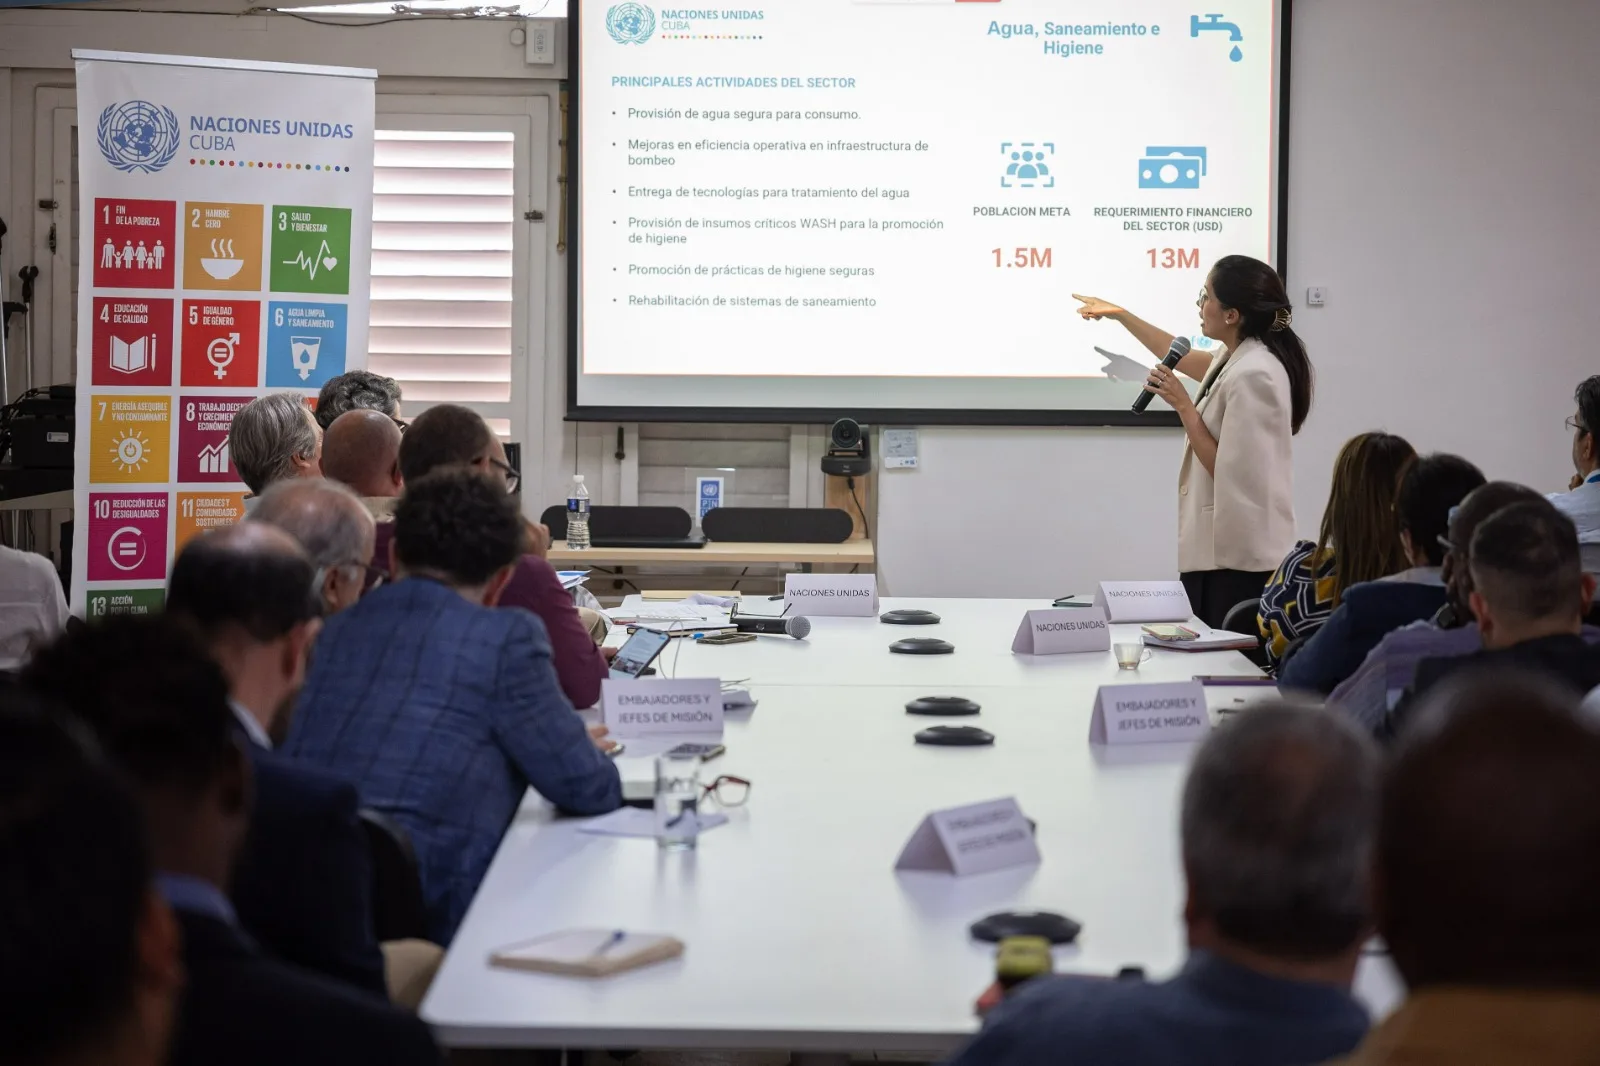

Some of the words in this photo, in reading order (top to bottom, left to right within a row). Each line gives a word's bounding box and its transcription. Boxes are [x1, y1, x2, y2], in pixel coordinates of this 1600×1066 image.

[662, 10, 718, 19] NACIONES
[722, 10, 764, 20] UNIDAS
[661, 20, 690, 30] CUBA
[987, 21, 1038, 38] Agua,
[1044, 21, 1146, 36] Saneamiento
[1151, 25, 1160, 35] e
[1044, 40, 1103, 58] Higiene
[612, 76, 692, 87] PRINCIPALES
[696, 77, 777, 87] ACTIVIDADES
[781, 77, 804, 88] DEL
[807, 78, 855, 88] SECTOR
[628, 108, 681, 118] Provisión
[685, 108, 699, 118] de
[702, 111, 730, 121] agua
[734, 111, 772, 121] segura
[776, 111, 801, 121] para
[805, 111, 861, 119] consumo.
[189, 116, 281, 135] NACIONES
[285, 121, 354, 139] UNIDAS
[189, 134, 236, 151] CUBA
[628, 139, 674, 152] Mejoras
[678, 142, 691, 150] en
[695, 139, 750, 150] eficiencia
[753, 141, 806, 152] operativa
[827, 140, 911, 151] infraestructura
[915, 140, 928, 151] de
[628, 154, 675, 165] bombeo
[629, 186, 672, 199] Entrega
[676, 186, 689, 197] de
[693, 186, 759, 200] tecnologías
[763, 189, 788, 199] para
[792, 187, 857, 197] tratamiento
[861, 187, 878, 197] del
[882, 190, 909, 200] agua
[103, 205, 109, 225] 1
[116, 205, 126, 214] FIN
[205, 209, 230, 219] HAMBRE
[973, 207, 1036, 216] POBLACION
[1040, 207, 1070, 216] META
[1094, 207, 1183, 217] REQUERIMIENTO
[1187, 208, 1252, 217] FINANCIERO
[115, 215, 124, 225] DE
[124, 216, 133, 226] LA
[132, 216, 160, 226] POBREZA
[191, 208, 200, 228] 2
[278, 212, 287, 231] 3
[291, 212, 311, 222] SALUD
[205, 219, 221, 229] CERO
[291, 222, 296, 231] Y
[295, 223, 328, 233] BIENESTAR
[629, 217, 681, 228] Provisión
[685, 217, 699, 228] de
[702, 218, 751, 228] insumos
[754, 219, 796, 228] críticos
[800, 218, 836, 228] WASH
[840, 221, 865, 231] para
[869, 218, 878, 228] la
[882, 219, 943, 231] promoción
[1124, 221, 1143, 230] DEL
[1146, 221, 1189, 231] SECTOR
[1193, 221, 1222, 233] (USD)
[628, 233, 642, 243] de
[646, 233, 687, 246] higiene
[992, 248, 1051, 268] 1.5M
[1147, 248, 1199, 269] 13M
[629, 264, 691, 275] Promoción
[695, 265, 708, 275] de
[712, 265, 764, 277] prácticas
[768, 265, 781, 275] de
[785, 265, 826, 278] higiene
[830, 268, 874, 278] seguras
[629, 295, 709, 306] Rehabilitación
[713, 296, 726, 306] de
[730, 296, 781, 306] sistemas
[785, 296, 799, 306] de
[803, 297, 876, 306] saneamiento
[100, 304, 109, 323] 4
[113, 303, 148, 313] EDUCACIÓN
[203, 306, 232, 315] IGUALDAD
[288, 308, 304, 317] AGUA
[305, 309, 325, 318] LIMPIA
[113, 314, 122, 323] DE
[122, 314, 148, 324] CALIDAD
[189, 305, 198, 325] 5
[203, 316, 211, 325] DE
[211, 315, 234, 326] GÉNERO
[274, 308, 284, 326] 6
[288, 319, 292, 327] Y
[292, 319, 334, 329] SANEAMIENTO
[98, 402, 107, 421] 7
[112, 401, 136, 411] ENERGÍA
[137, 402, 168, 412] ASEQUIBLE
[185, 402, 196, 422] 8
[198, 402, 226, 412] TRABAJO
[112, 412, 116, 421] Y
[117, 412, 125, 421] NO
[125, 412, 168, 422] CONTAMINANTE
[198, 412, 203, 421] Y
[112, 498, 146, 508] REDUCCIÓN
[146, 499, 154, 508] DE
[154, 499, 166, 508] LAS
[181, 498, 194, 518] 11
[196, 498, 225, 507] CIUDADES
[224, 498, 230, 507] Y
[93, 499, 110, 519] 10
[112, 509, 160, 519] DESIGUALDADES
[196, 507, 237, 517] COMUNIDADES
[111, 594, 133, 605] ACCIÓN
[789, 588, 835, 599] NACIONES
[836, 588, 870, 599] UNIDAS
[1108, 590, 1151, 598] NACIONES
[91, 596, 107, 616] 13
[1036, 622, 1076, 633] NACIONES
[1076, 620, 1106, 630] UNIDAS
[617, 694, 703, 706] EMBAJADORES
[703, 695, 711, 705] Y
[1115, 700, 1189, 713] EMBAJADORES
[1188, 698, 1197, 708] Y
[618, 712, 651, 723] JEFES
[652, 713, 670, 723] DE
[671, 710, 713, 723] MISIÓN
[1117, 720, 1147, 731] JEFES
[1147, 718, 1163, 729] DE
[1163, 714, 1200, 728] MISIÓN
